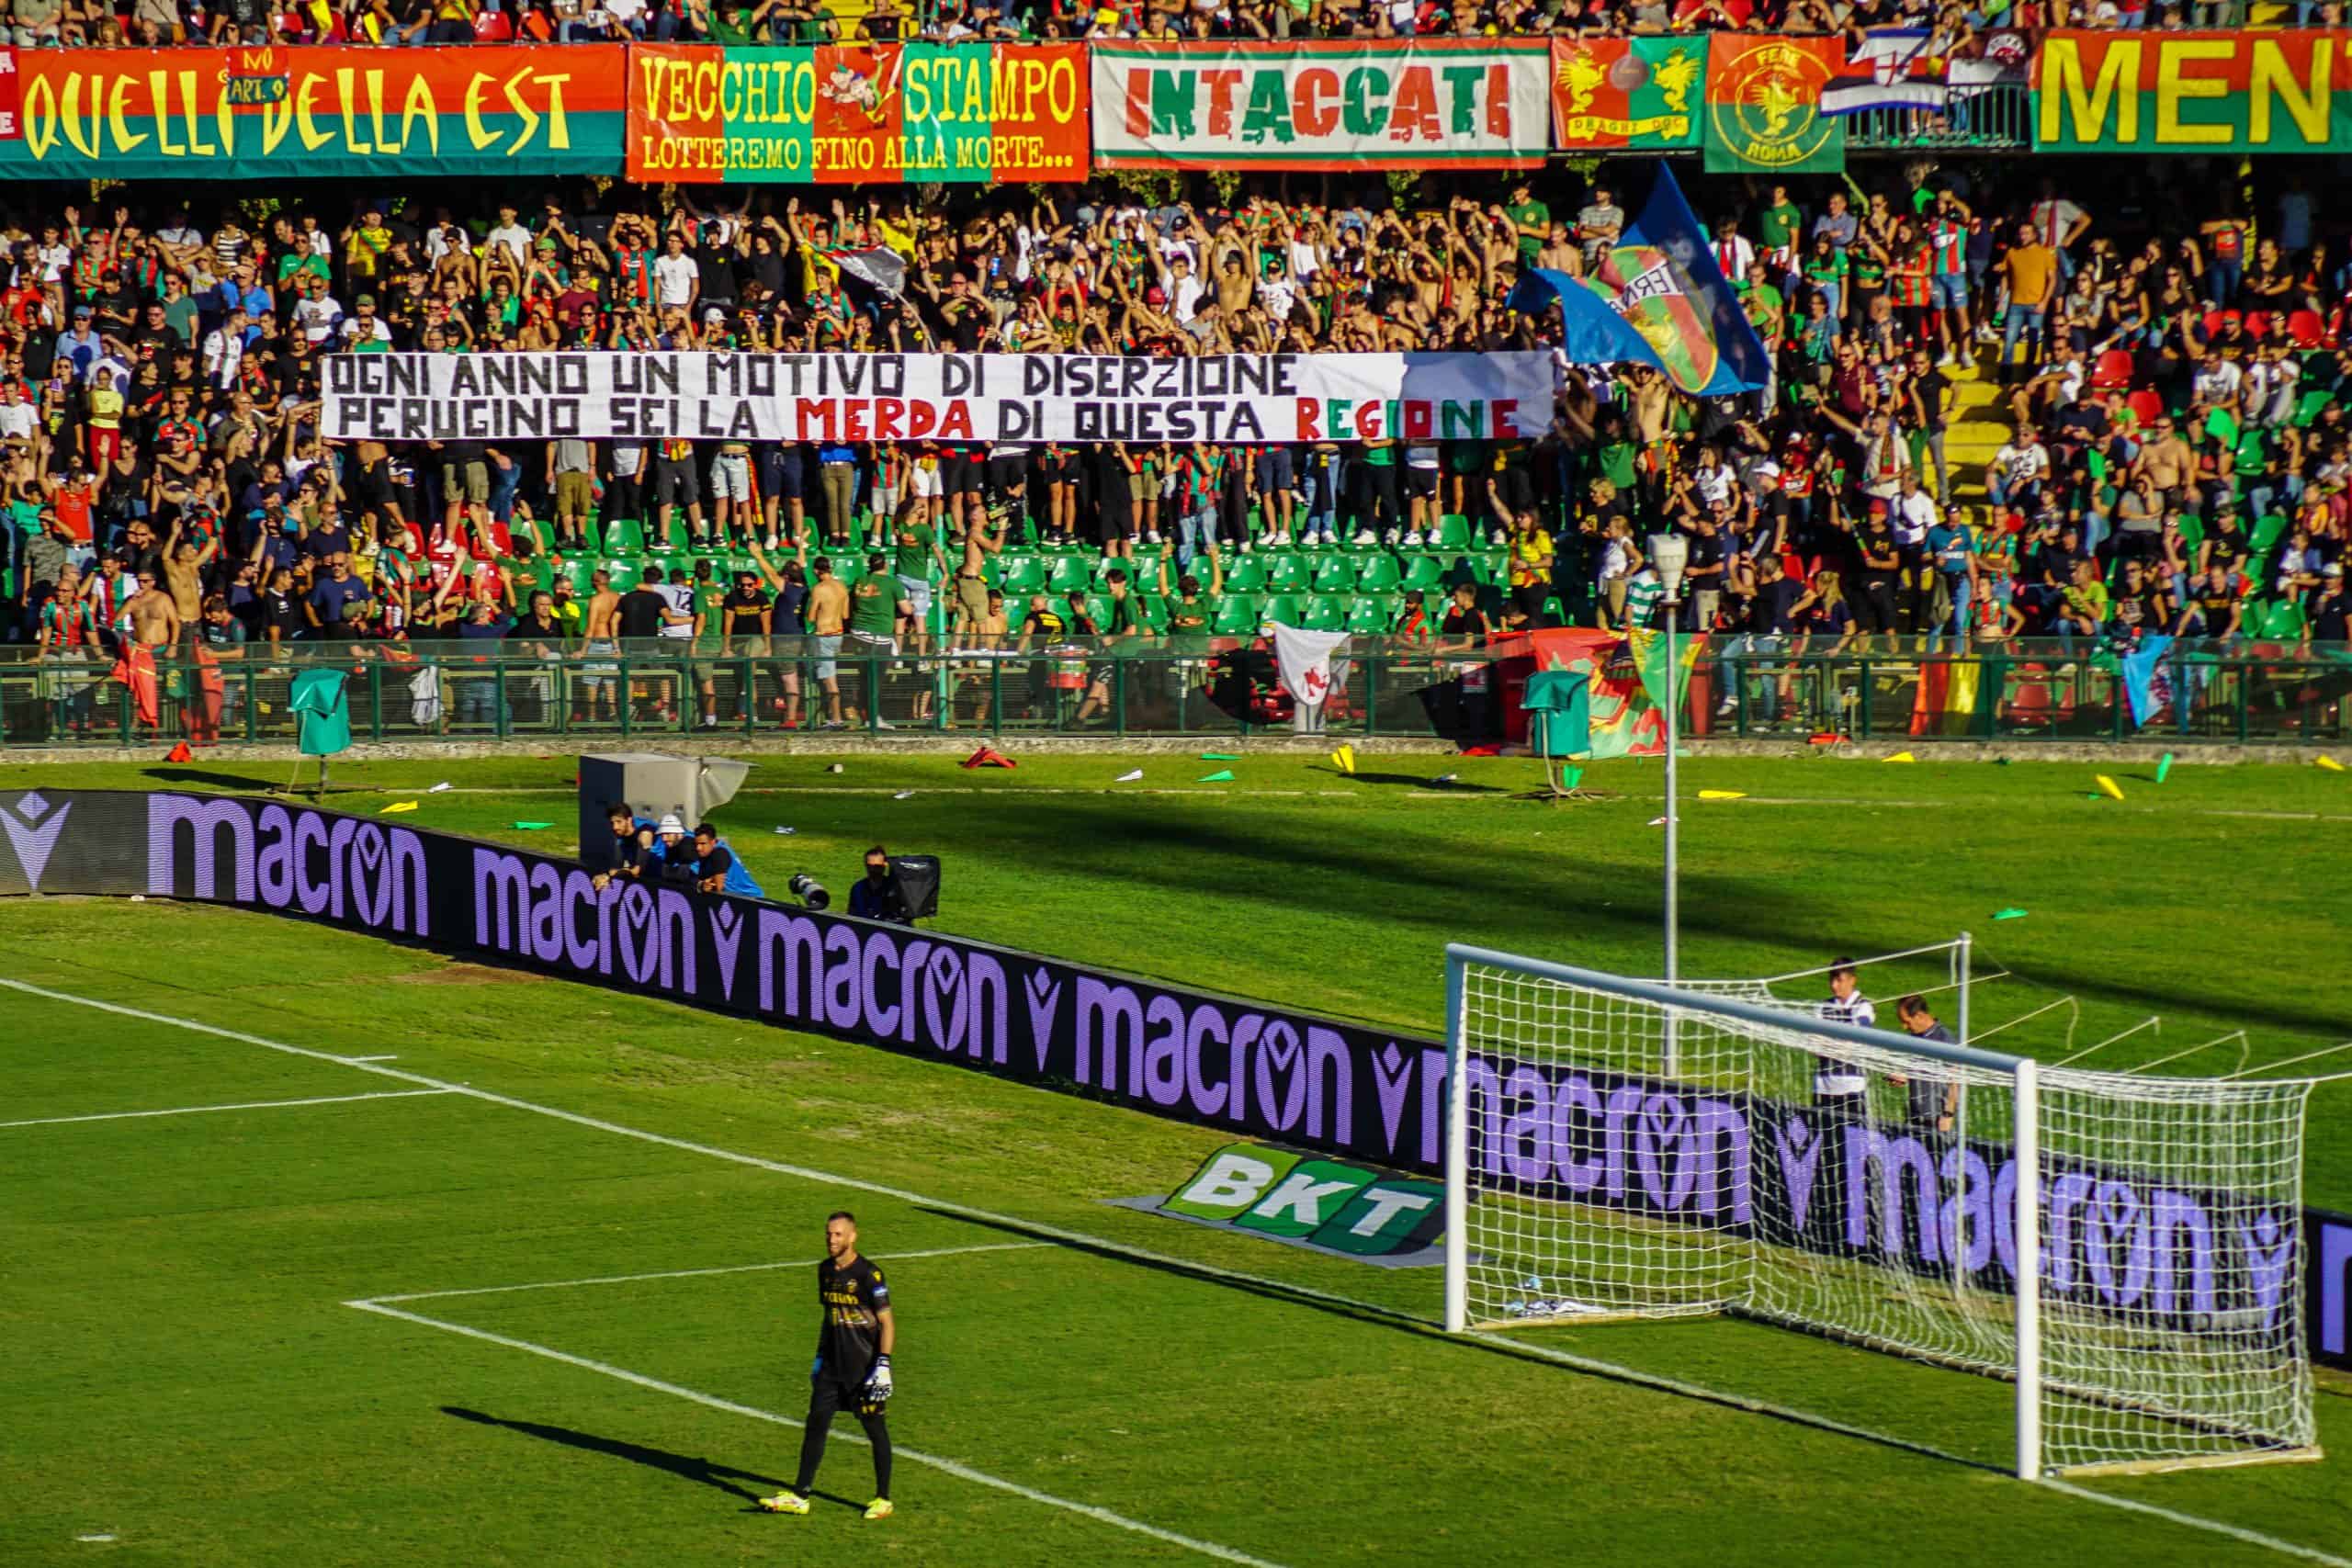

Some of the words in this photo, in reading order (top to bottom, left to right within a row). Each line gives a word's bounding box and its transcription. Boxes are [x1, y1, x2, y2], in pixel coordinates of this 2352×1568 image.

[243, 47, 273, 72] NO
[639, 57, 817, 124] VECCHIO
[904, 57, 1077, 124] STAMPO
[2039, 38, 2352, 144] MEN
[263, 67, 438, 157] DELLA
[464, 66, 571, 156] EST
[1125, 64, 1511, 144] INTACCATI
[642, 136, 802, 170] LOTTEREMO
[810, 137, 876, 170] FINO
[882, 137, 948, 169] ALLA
[956, 136, 1074, 169] MORTE...
[1747, 141, 1802, 161] ROMA
[330, 354, 429, 395] OGNI
[451, 355, 589, 396] ANNO
[613, 355, 680, 396] UN
[707, 354, 905, 398] MOTIVO
[943, 355, 985, 397] DI
[1023, 354, 1298, 397] DISERZIONE
[339, 397, 581, 439] PERUGINO
[610, 398, 679, 437] SEI
[700, 400, 760, 437] LA
[796, 397, 974, 441] MERDA
[999, 400, 1044, 440] DI
[1073, 400, 1264, 441] QUESTA
[1296, 399, 1519, 438] REGIONE
[148, 793, 429, 937] macron
[474, 847, 697, 995] macron
[759, 908, 1009, 1065] macron
[1075, 975, 1353, 1145] macron
[1420, 1048, 1752, 1224] macron
[1181, 1154, 1434, 1238] BKT
